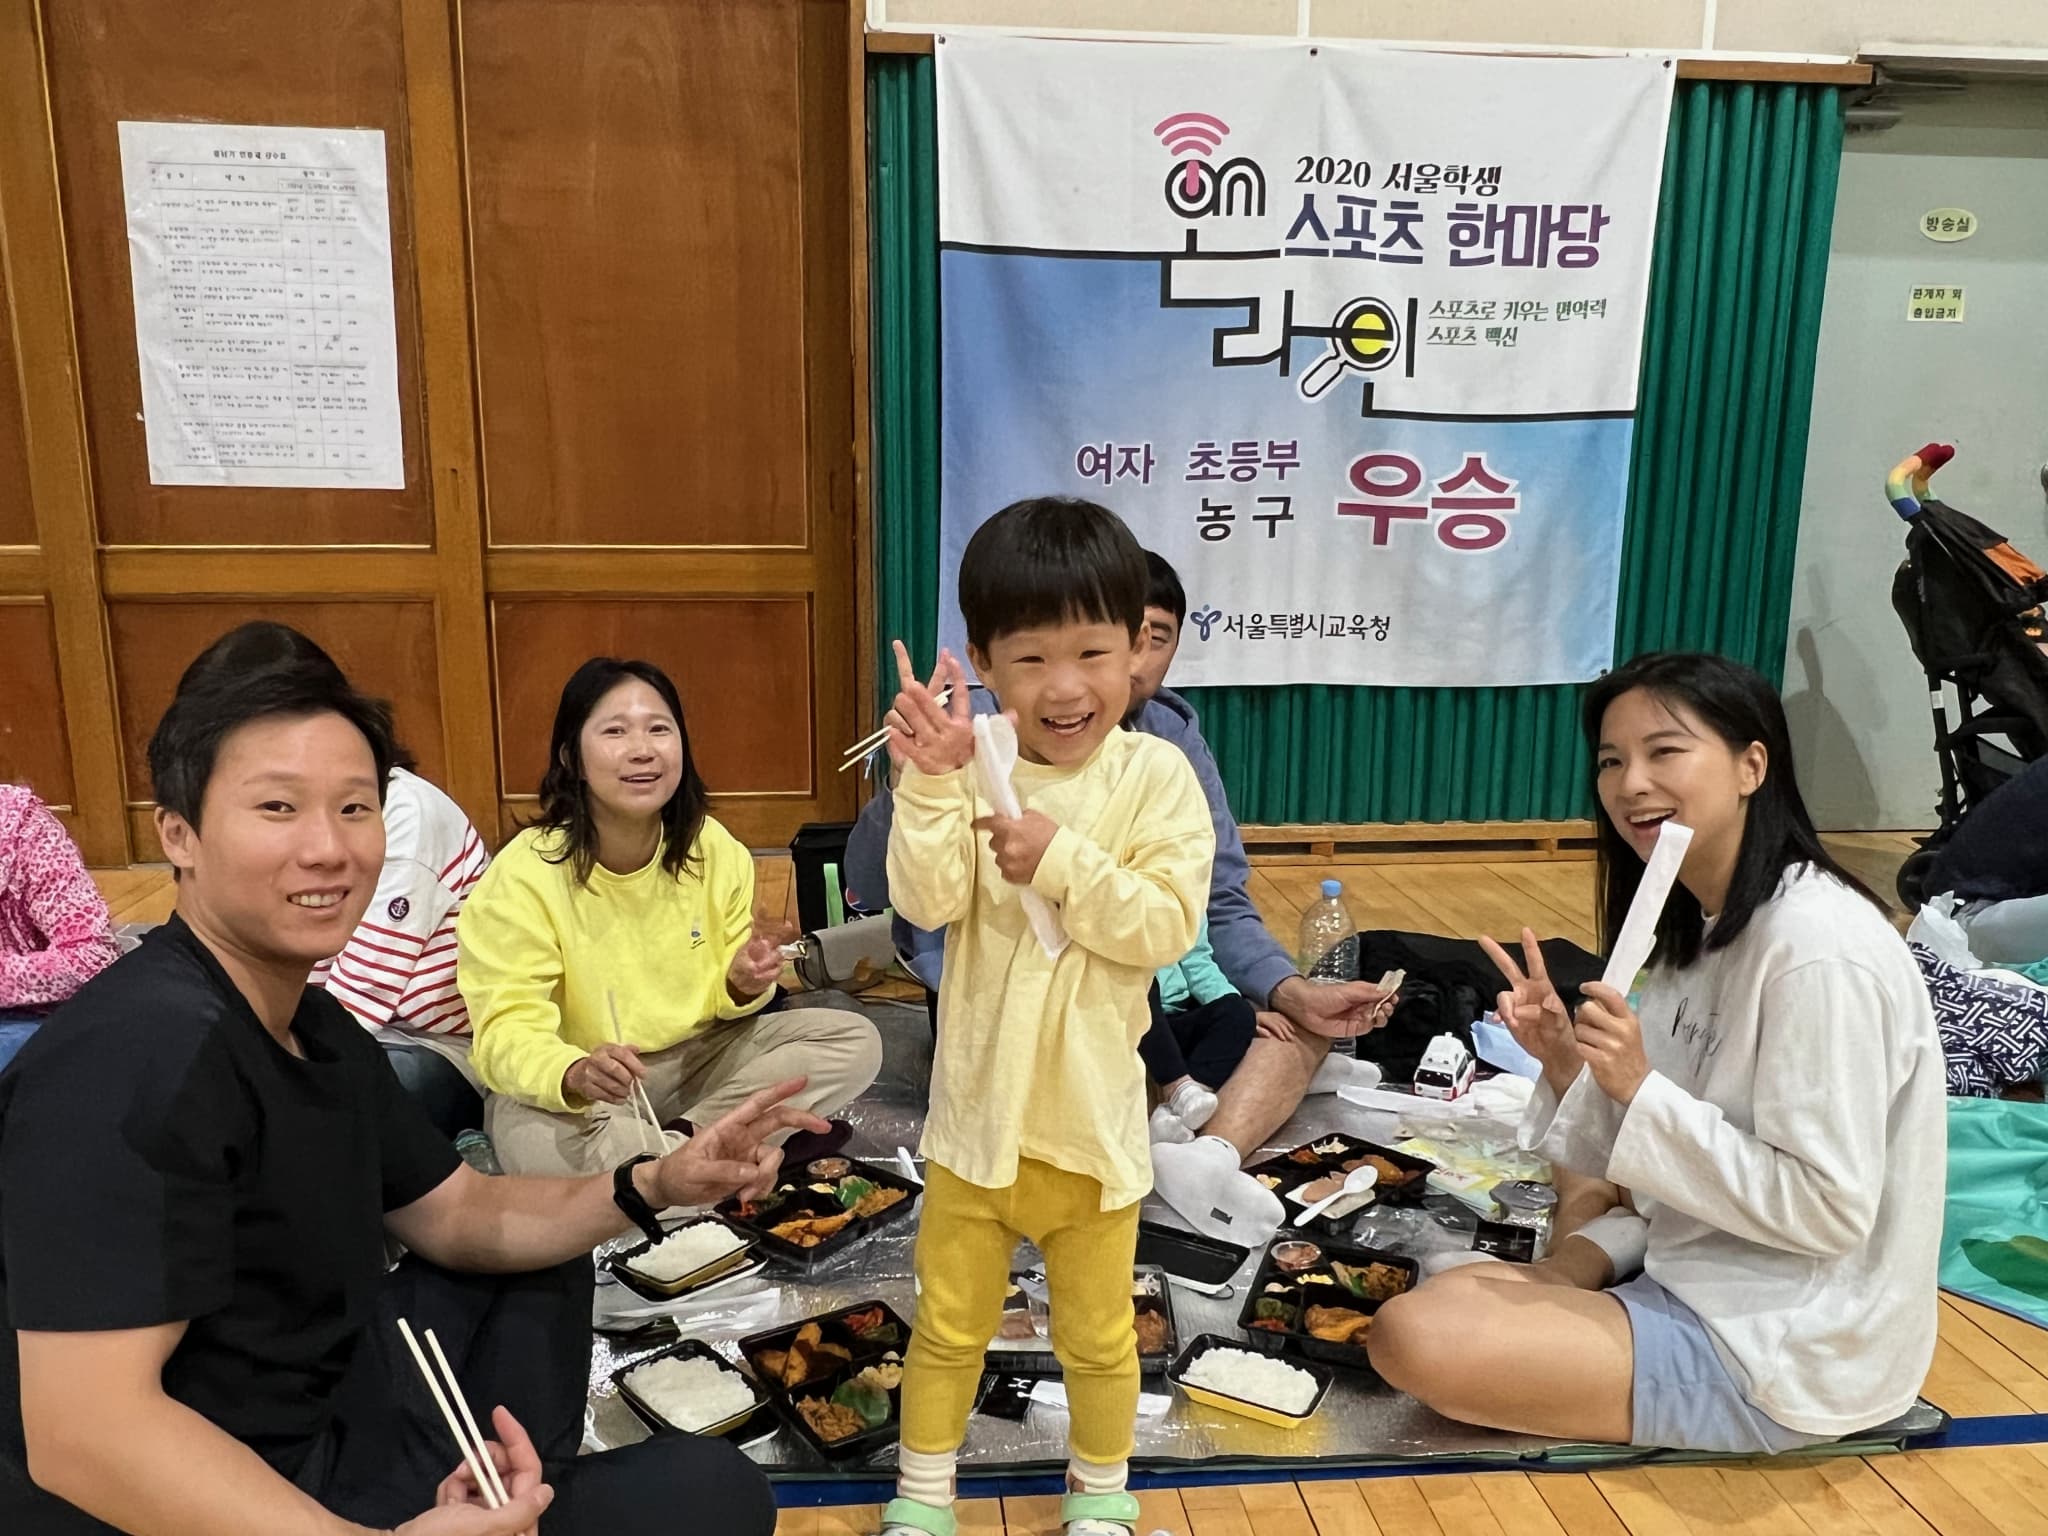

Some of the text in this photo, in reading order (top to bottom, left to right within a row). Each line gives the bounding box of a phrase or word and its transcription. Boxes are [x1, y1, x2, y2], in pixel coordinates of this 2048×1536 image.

[1294, 155, 1503, 197] 2020 서울학생
[1284, 192, 1611, 269] 스포츠 한마당
[1926, 215, 1970, 233] 방송실
[1913, 288, 1945, 300] 관계자
[1428, 298, 1608, 322] 스포츠로 키우는 면역력
[1913, 307, 1957, 319] 출입금지
[1426, 325, 1519, 347] 스포츠 백신
[1076, 439, 1301, 484] 여자 초등부
[1336, 451, 1517, 551] 우승
[1222, 613, 1392, 642] 서울특별시교육청
